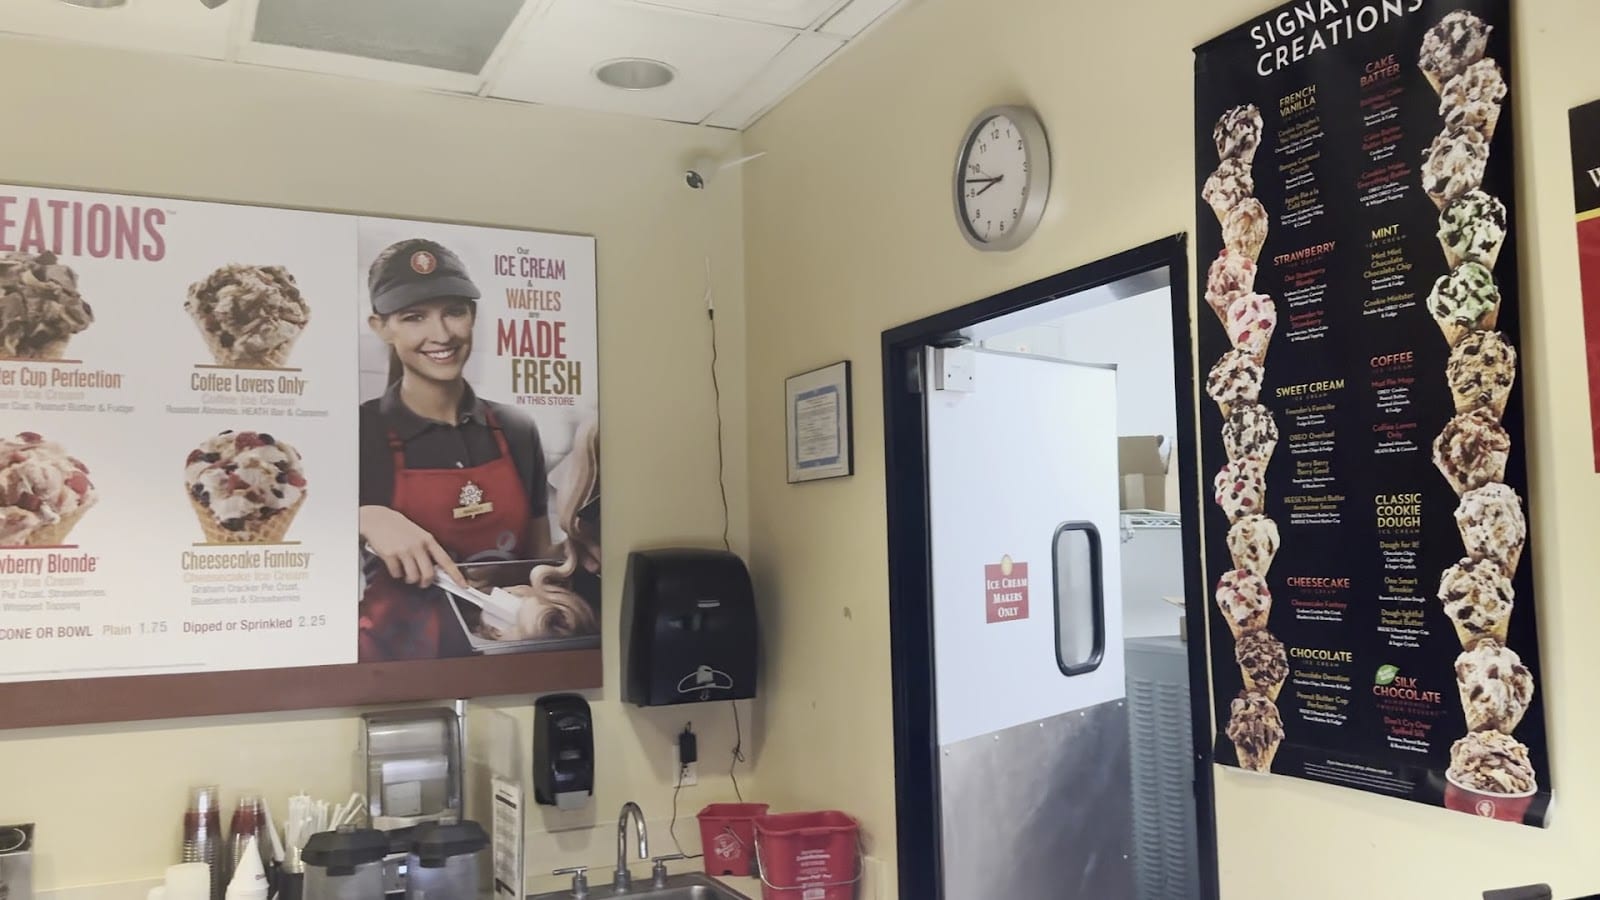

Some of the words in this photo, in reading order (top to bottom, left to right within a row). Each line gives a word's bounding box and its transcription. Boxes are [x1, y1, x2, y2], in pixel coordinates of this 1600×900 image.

[1366, 54, 1395, 73] CAKE
[1360, 63, 1400, 87] BATTER
[1280, 85, 1316, 108] FRENCH
[1280, 96, 1317, 117] VANILLA
[991, 128, 999, 140] 12
[1371, 224, 1399, 240] MINT
[517, 247, 530, 255] Our
[1274, 241, 1335, 266] STRAWBERRY
[494, 254, 516, 277] ICE
[520, 256, 566, 280] CREAM
[527, 279, 533, 288] &
[506, 288, 561, 312] WAFFLES
[497, 318, 566, 359] MADE
[1370, 351, 1413, 367] COFFEE
[20, 366, 47, 388] Cup
[51, 367, 121, 389] Perfection
[191, 372, 231, 392] Coffee
[235, 374, 275, 394] Lovers
[278, 376, 305, 396] Only
[511, 358, 582, 395] FRESH
[1276, 384, 1308, 397] SWEET
[1309, 379, 1345, 392] CREAM
[516, 395, 525, 405] IN
[527, 395, 546, 405] THIS
[548, 396, 575, 406] STORE
[1375, 493, 1422, 505] CLASSIC
[1376, 505, 1421, 516] COOKIE
[1377, 516, 1420, 528] DOUGH
[48, 553, 96, 573] Blonde
[182, 550, 260, 570] Cheesecake
[264, 549, 310, 569] Fantasy
[987, 579, 1000, 590] ICE
[1002, 577, 1027, 589] CREAM
[1287, 577, 1350, 588] CHEESECAKE
[998, 606, 1019, 618] ONLY
[0, 628, 32, 640] CONE
[36, 627, 54, 639] OR
[58, 625, 94, 638] BOWL
[102, 624, 132, 636] Plain
[139, 621, 168, 634] 1.75
[183, 620, 223, 634] Dipped
[226, 621, 237, 631] or
[240, 618, 293, 633] Sprinkled
[298, 615, 326, 628] 2.25
[1290, 647, 1352, 662] CHOCOLATE
[1394, 676, 1417, 688] SILK
[1373, 685, 1441, 703] CHOCOLATE
